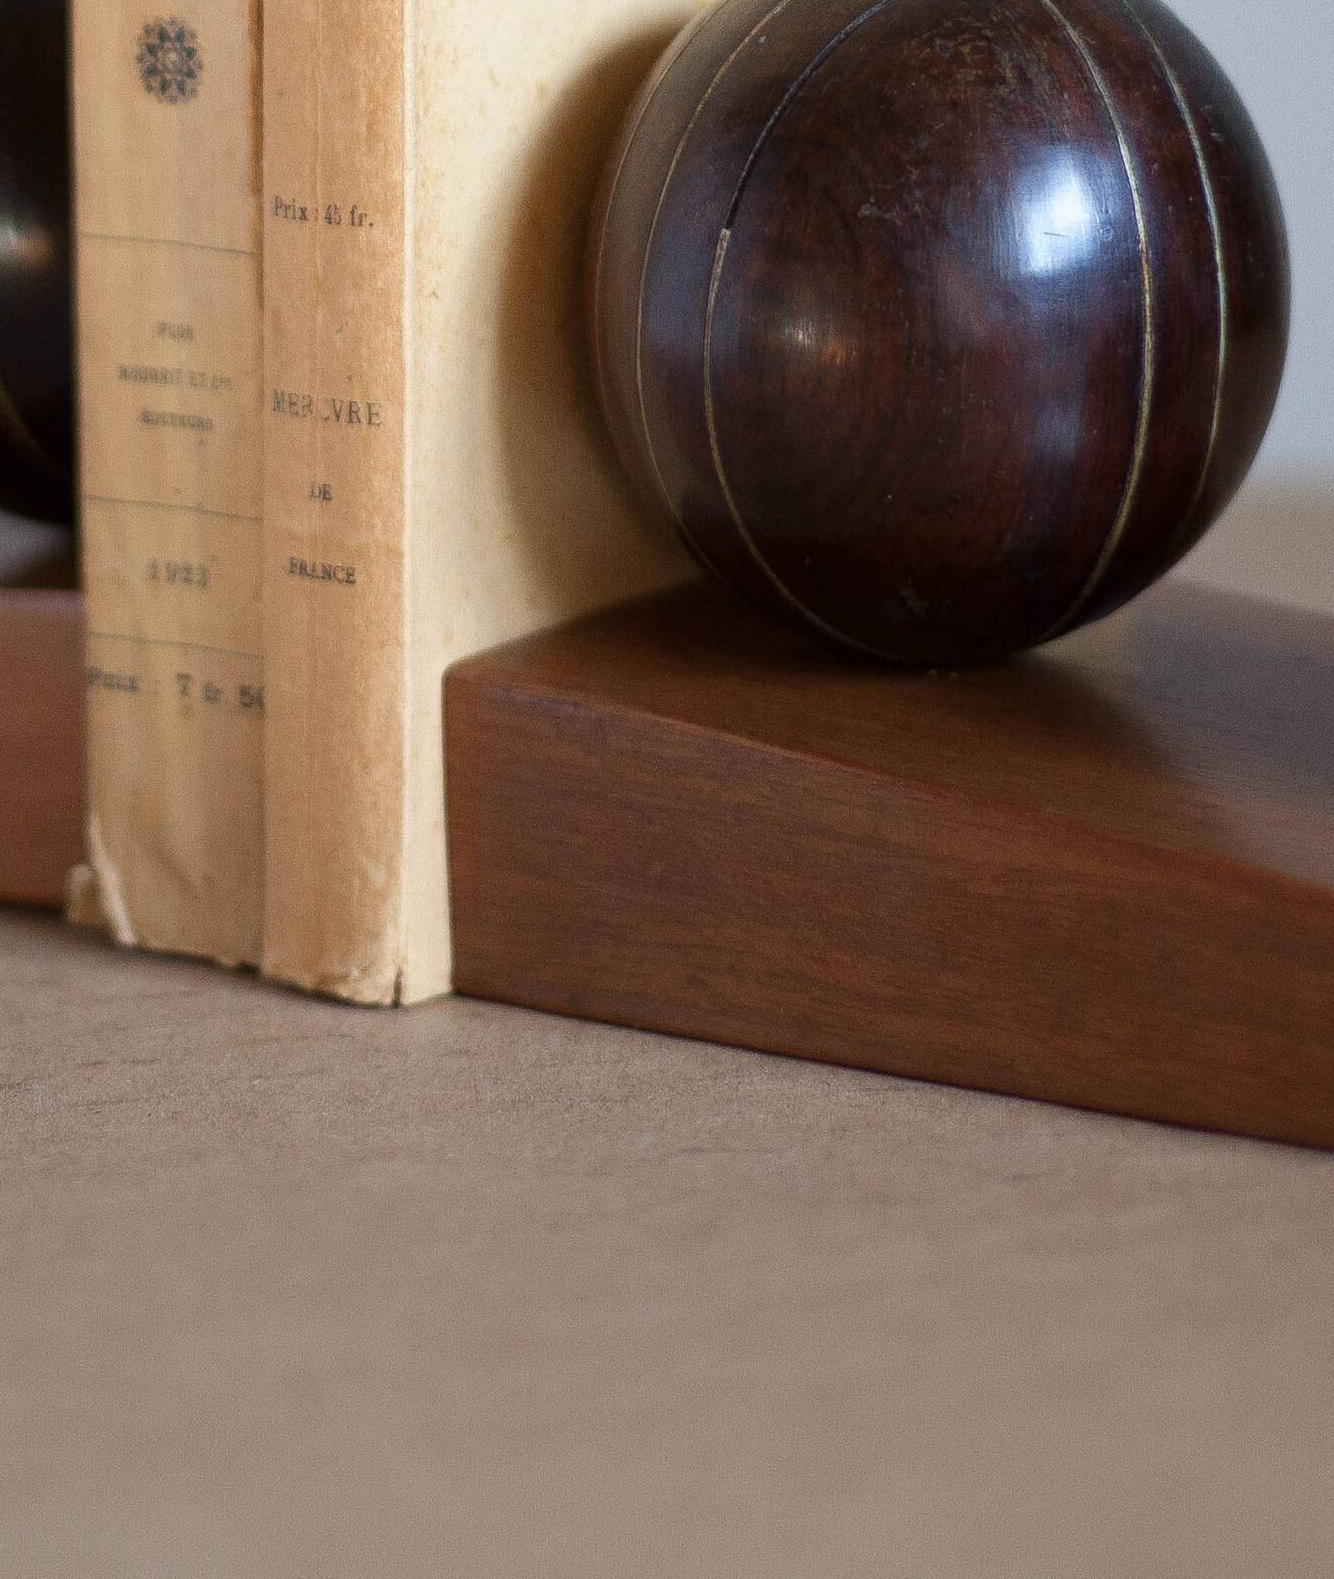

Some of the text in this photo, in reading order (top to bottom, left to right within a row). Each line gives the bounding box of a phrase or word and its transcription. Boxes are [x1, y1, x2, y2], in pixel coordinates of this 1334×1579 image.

[273, 195, 309, 222] Prix
[273, 388, 383, 427] MERVRE
[288, 556, 357, 584] FRANCE
